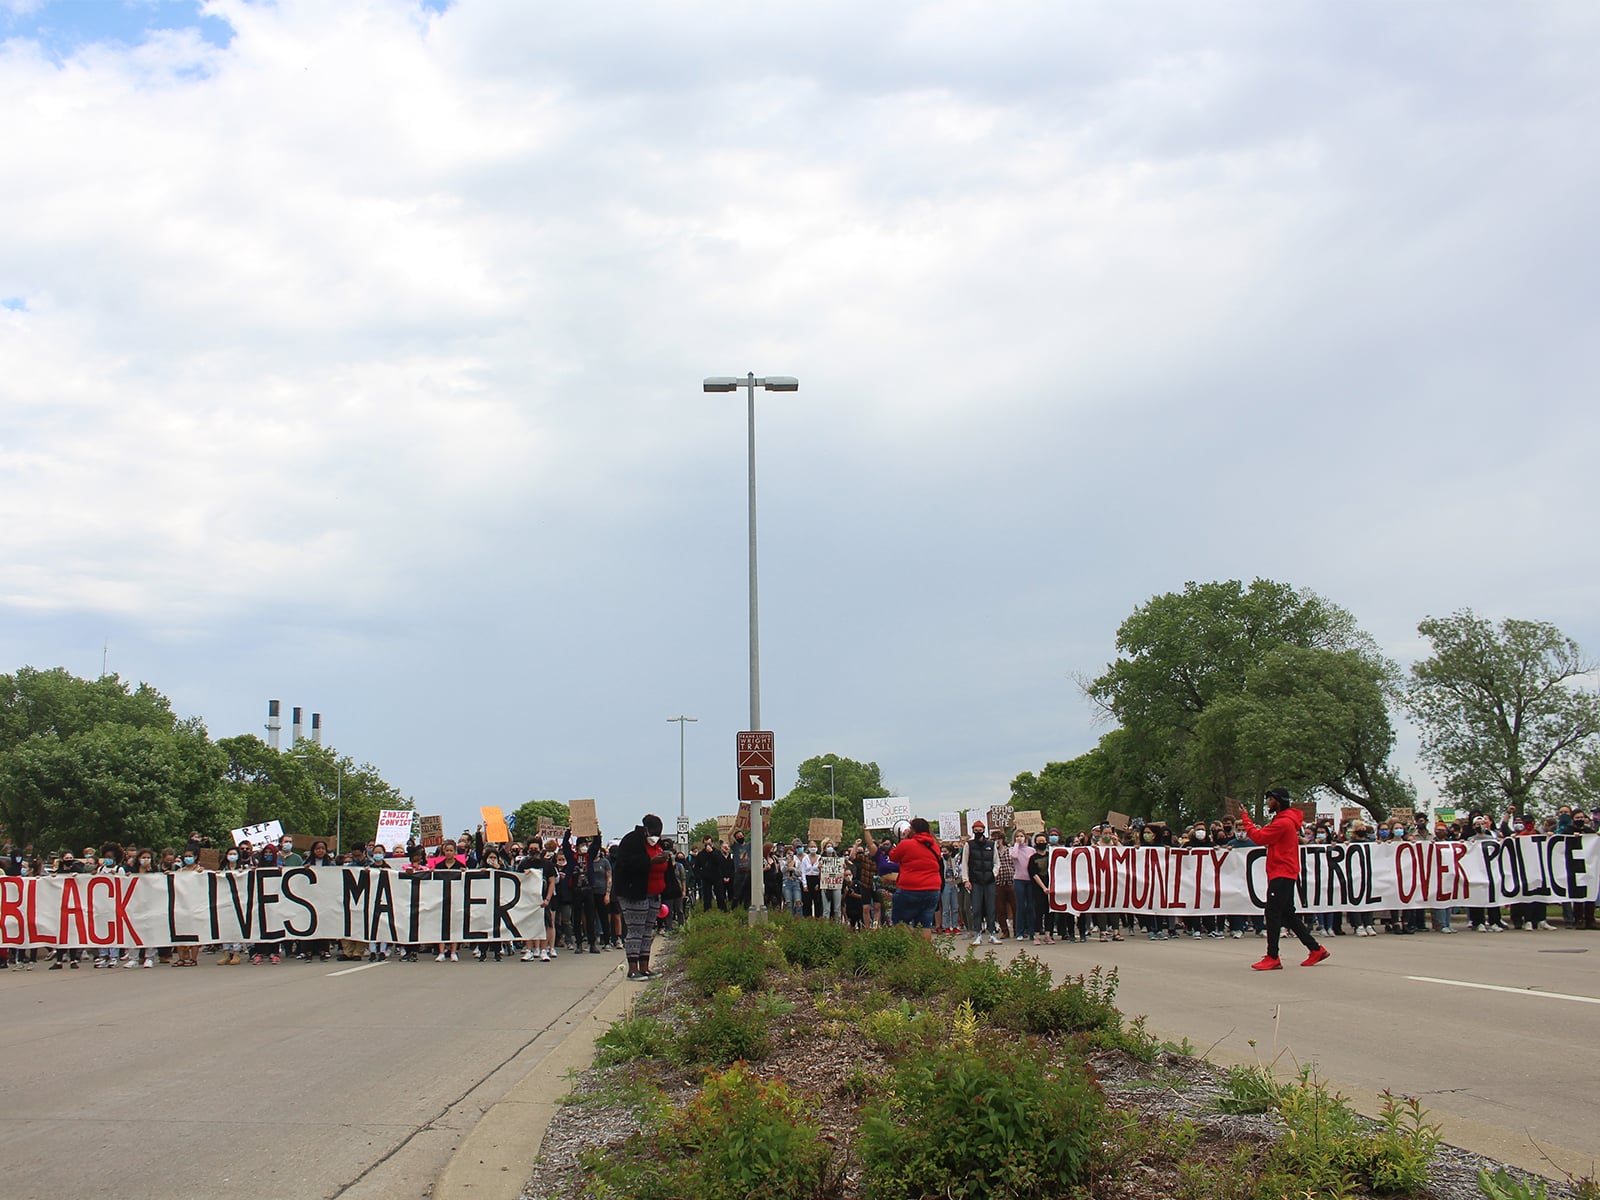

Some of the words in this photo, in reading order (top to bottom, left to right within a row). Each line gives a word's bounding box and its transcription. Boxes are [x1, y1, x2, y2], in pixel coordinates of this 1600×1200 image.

[865, 800, 889, 810] BLACK
[991, 805, 1014, 813] DEFEND
[882, 806, 909, 816] QUEER
[866, 817, 884, 827] LIVES
[992, 813, 1012, 821] BLACK
[380, 819, 412, 827] CONVICT
[994, 820, 1010, 828] LIFE
[242, 822, 271, 837] RIP
[1049, 846, 1230, 912] COMMUNITY
[1246, 844, 1382, 909] CNTROL
[1396, 842, 1470, 904] OVER
[1481, 836, 1588, 903] POLICE
[0, 876, 144, 946] BLACK
[167, 867, 319, 942] LIVES
[342, 869, 522, 942] MATTER
